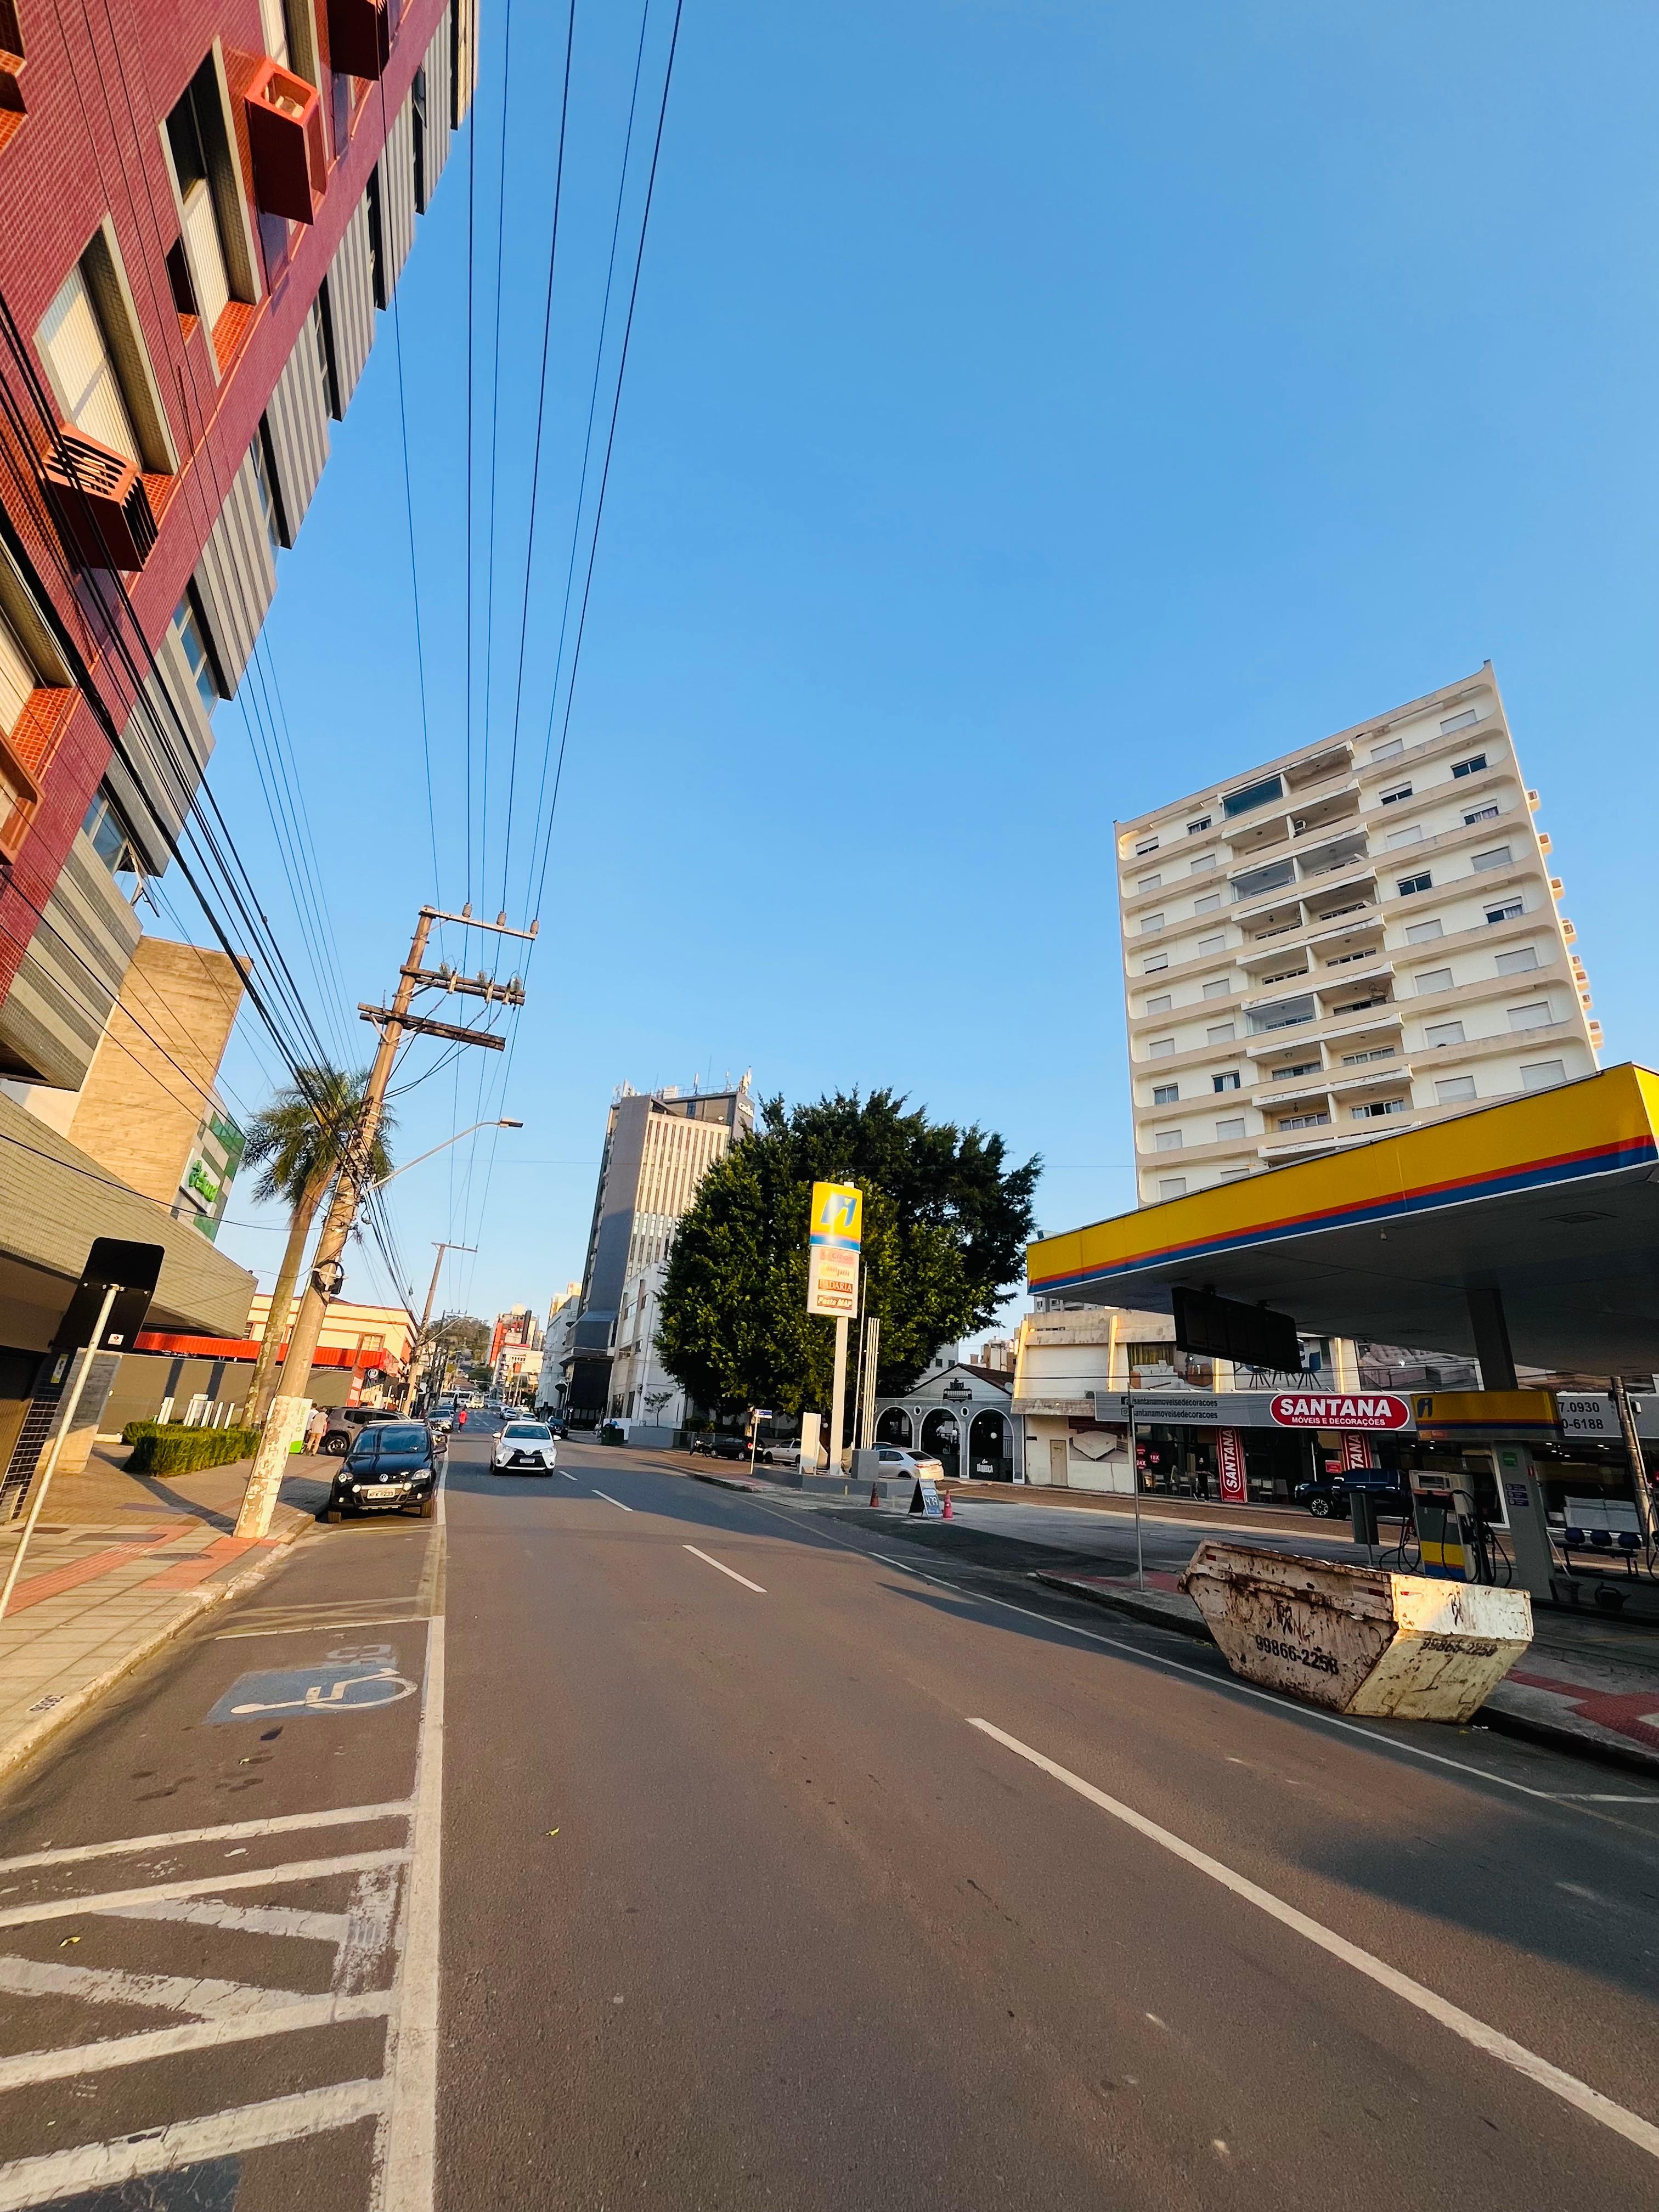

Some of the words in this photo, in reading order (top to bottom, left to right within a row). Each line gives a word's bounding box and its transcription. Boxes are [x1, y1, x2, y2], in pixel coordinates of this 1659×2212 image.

[1134, 1409, 1218, 1419] antanamoveisedecoracoes
[1280, 1399, 1392, 1417] SANTANA
[1292, 1416, 1321, 1424] MÓVEIS
[1329, 1418, 1386, 1426] DECORAÇÕES
[1222, 1430, 1238, 1488] SANTANA
[1255, 1635, 1339, 1675] 99866-2258
